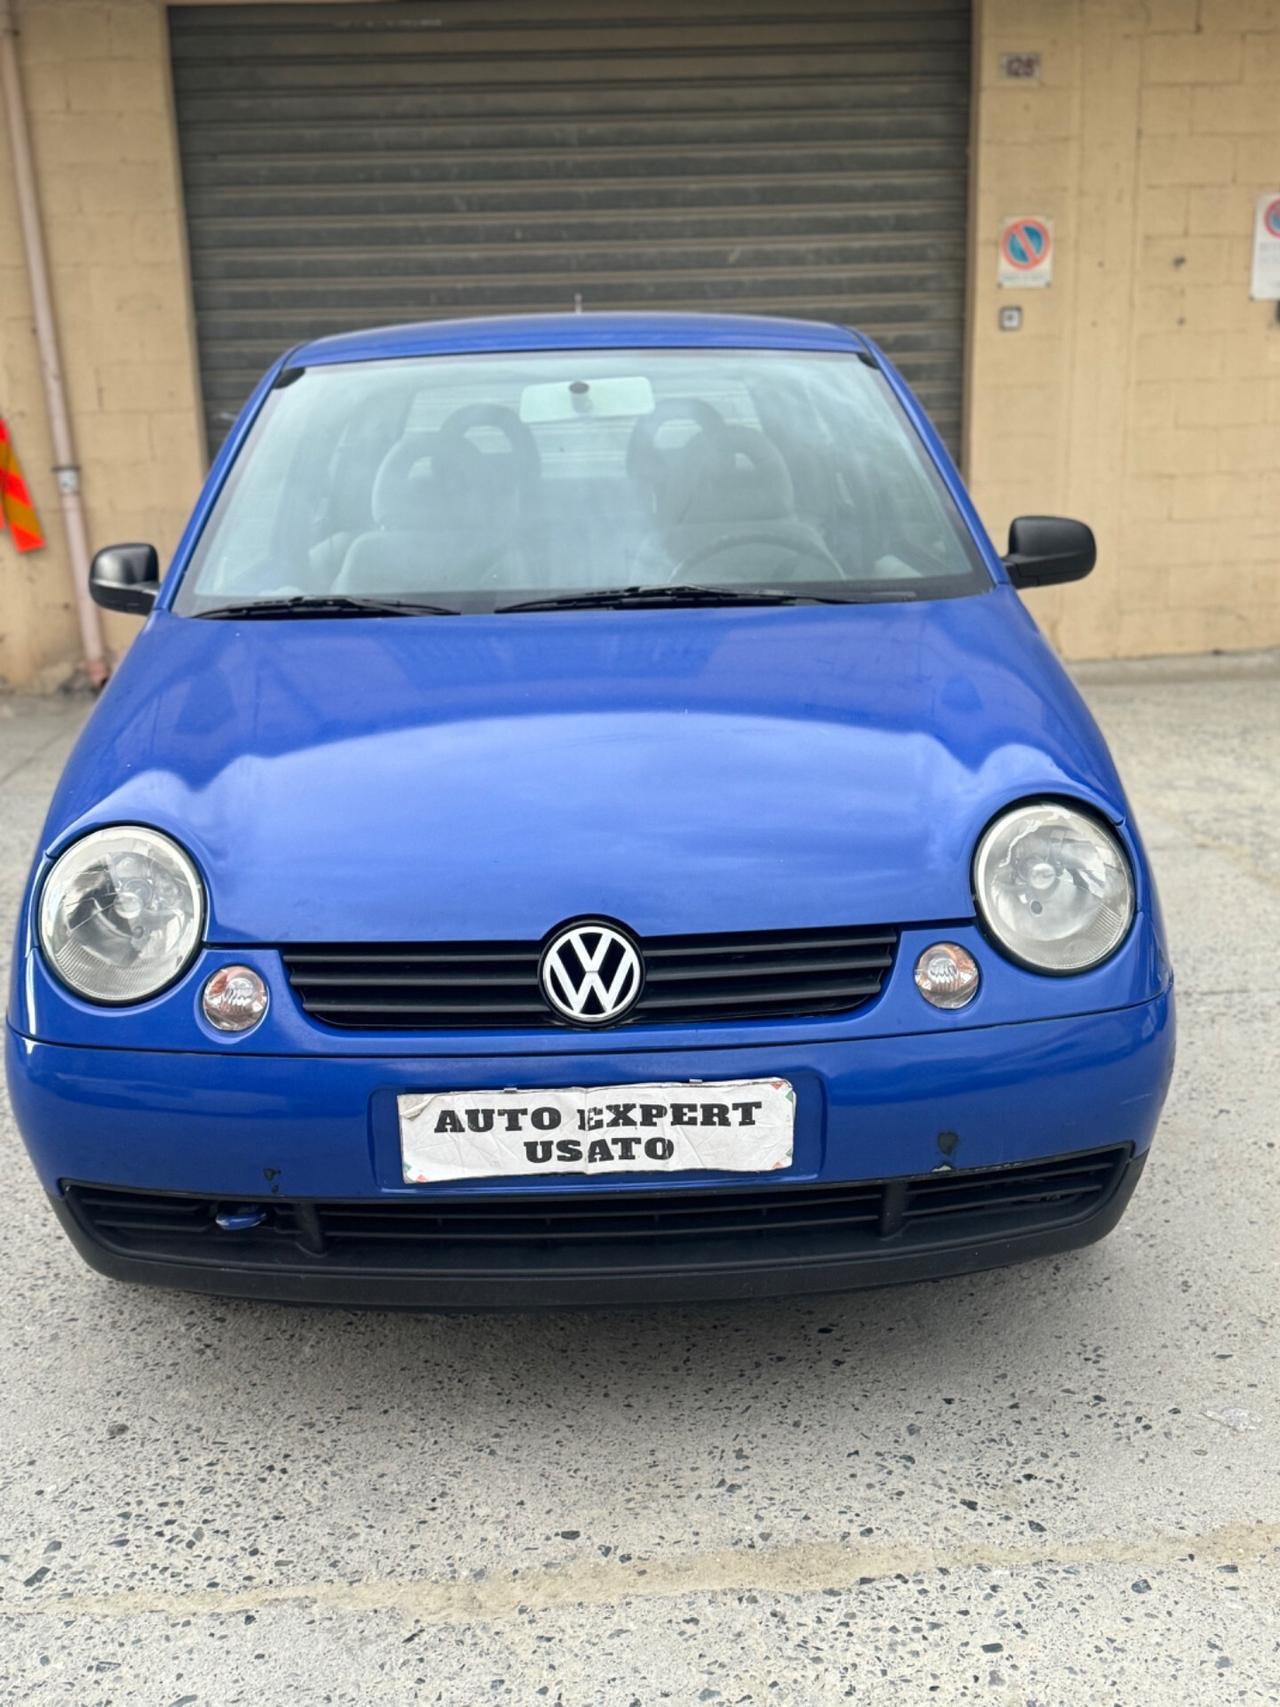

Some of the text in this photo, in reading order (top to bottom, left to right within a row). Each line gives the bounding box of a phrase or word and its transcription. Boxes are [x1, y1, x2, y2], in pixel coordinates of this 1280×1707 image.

[543, 926, 640, 1021] VW
[434, 1101, 763, 1133] AUTO EXPERT
[523, 1138, 675, 1164] USATO
